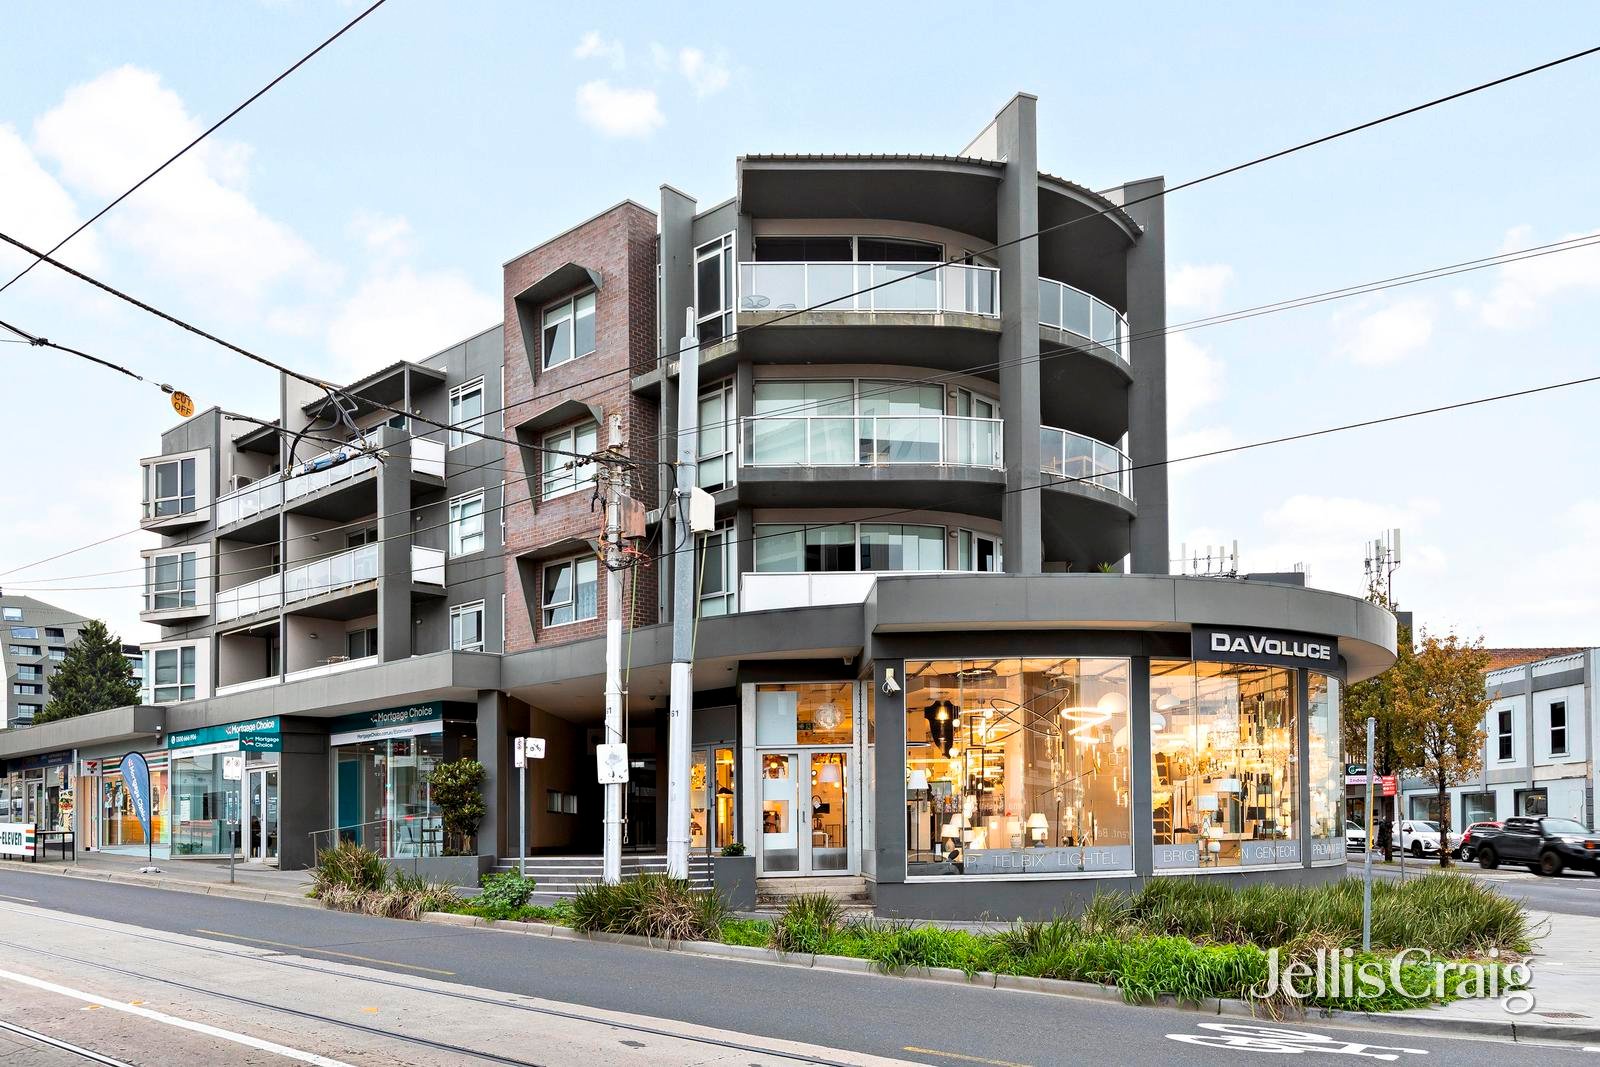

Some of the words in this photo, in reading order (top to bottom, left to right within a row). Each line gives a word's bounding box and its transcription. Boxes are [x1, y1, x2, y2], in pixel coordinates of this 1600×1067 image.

[174, 392, 192, 406] CUT
[174, 402, 191, 415] OFF
[378, 709, 408, 722] Mortgage
[409, 706, 433, 718] Choice
[231, 723, 256, 735] Mortgage
[256, 719, 275, 731] Choice
[129, 765, 140, 799] Mortgage
[137, 798, 146, 822] Choice
[1255, 845, 1296, 859] GENTECH
[992, 854, 1045, 868] TELBIX
